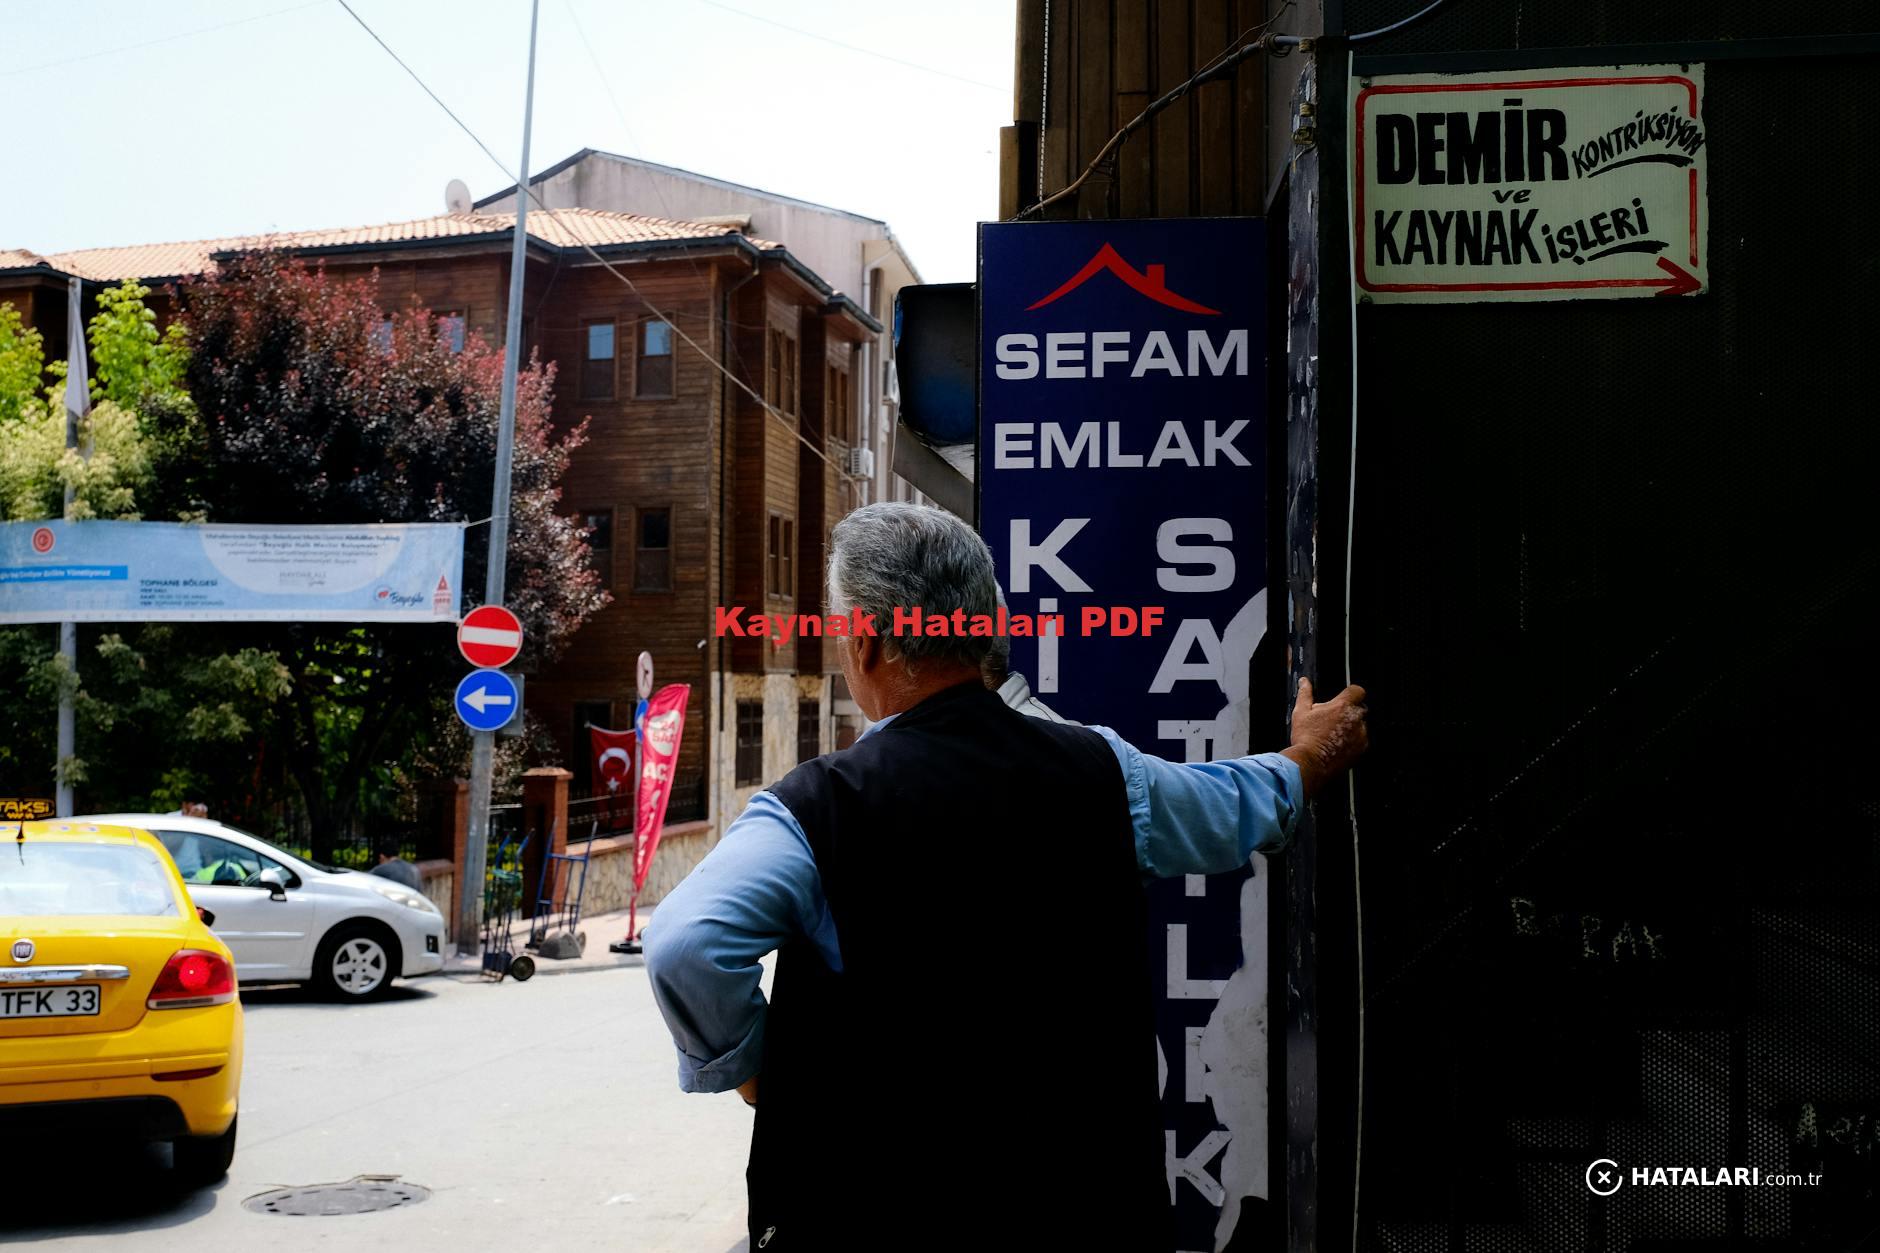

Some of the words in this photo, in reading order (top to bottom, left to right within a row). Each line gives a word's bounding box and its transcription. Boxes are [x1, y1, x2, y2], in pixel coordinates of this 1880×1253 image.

[1375, 98, 1569, 185] DEMİR
[1492, 189, 1532, 204] ve
[1374, 208, 1542, 266] KAYNAK
[995, 329, 1248, 380] SEFAM
[994, 419, 1252, 469] EMLAK
[1, 990, 54, 1014] TFK
[66, 989, 96, 1012] 33
